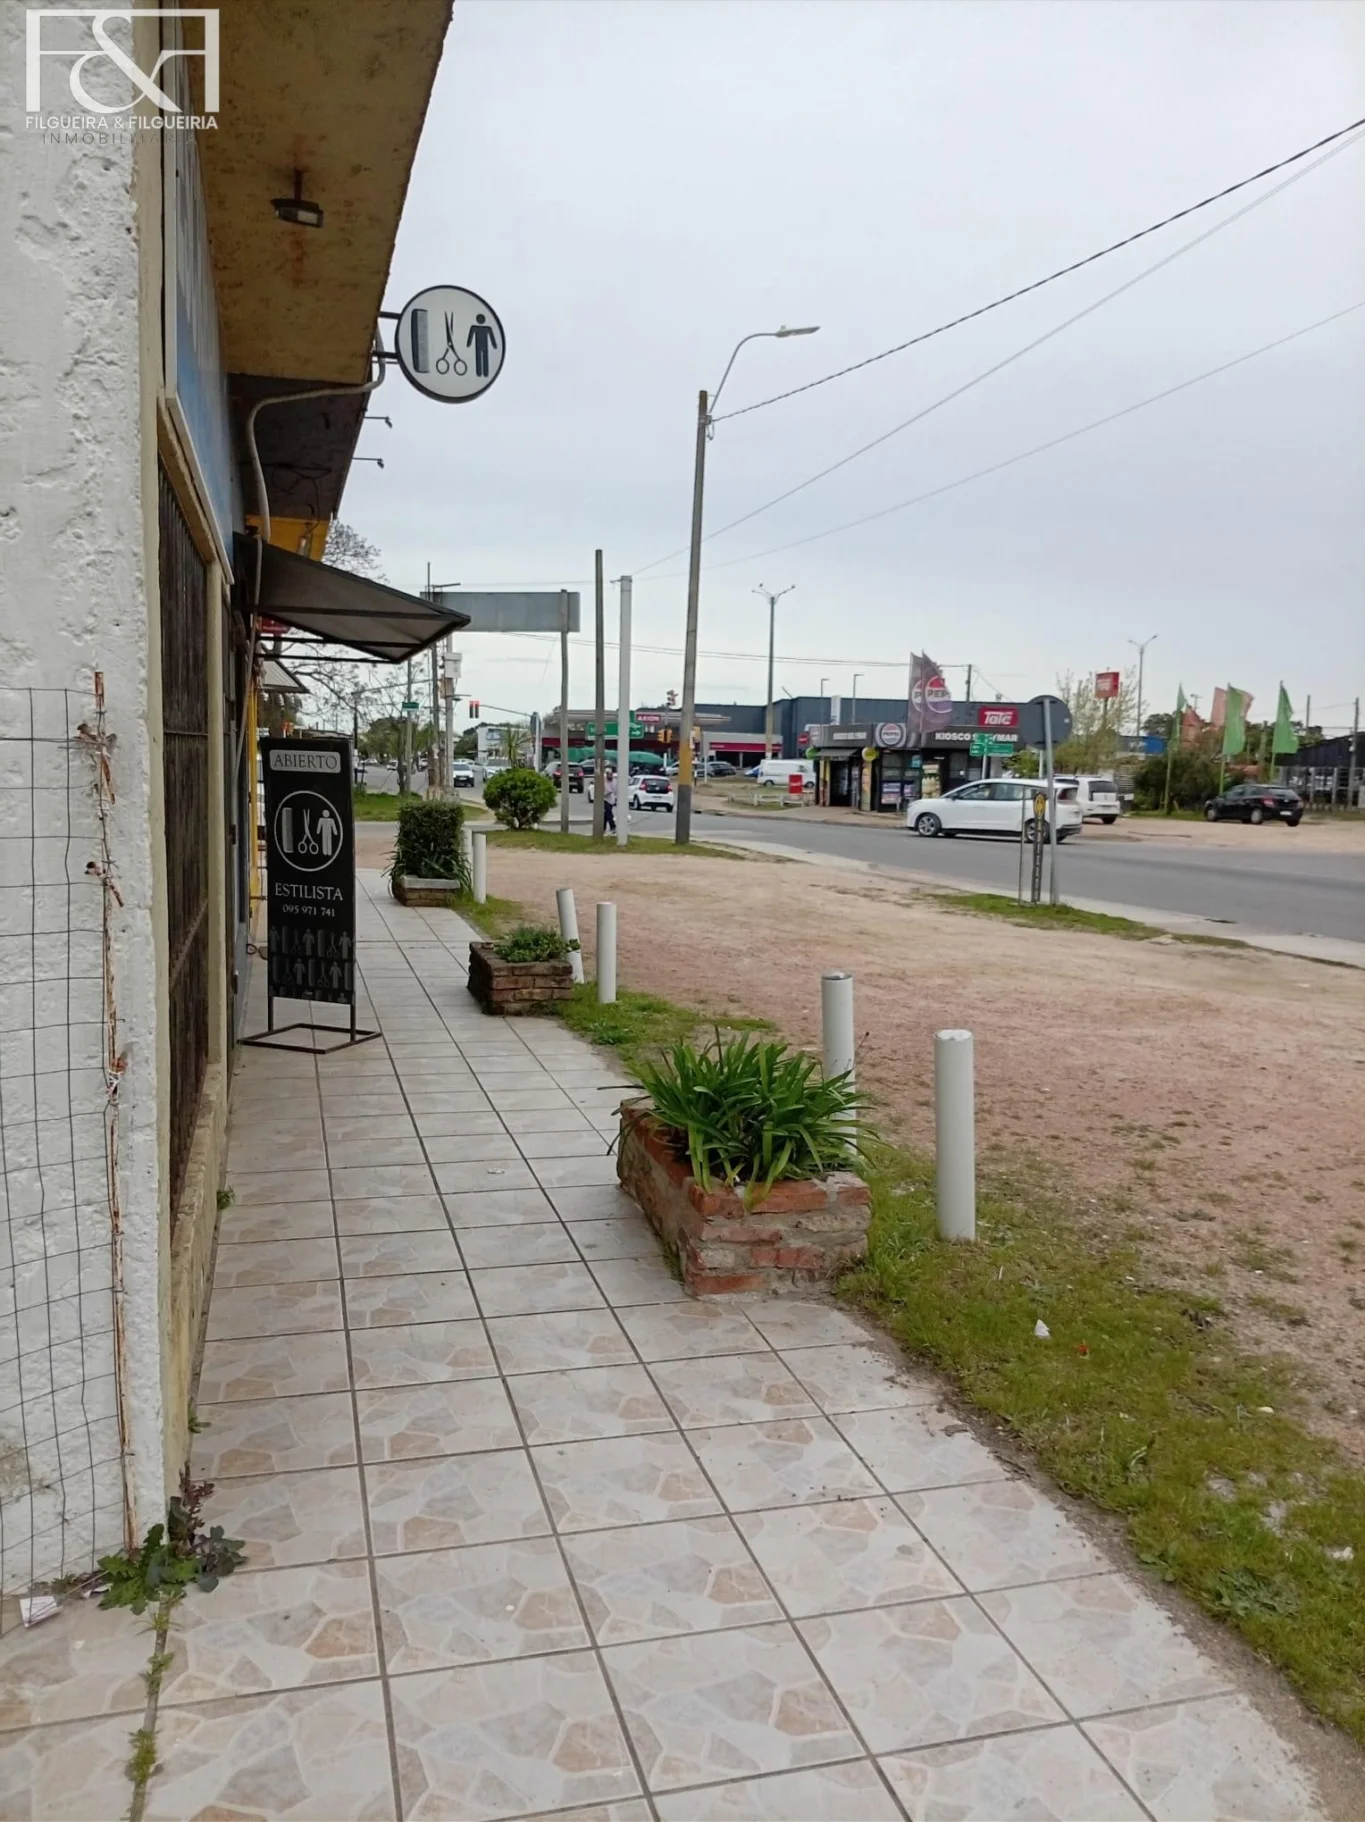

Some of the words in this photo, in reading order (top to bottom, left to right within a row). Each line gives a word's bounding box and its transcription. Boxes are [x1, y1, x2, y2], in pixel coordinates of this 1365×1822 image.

[935, 732, 971, 741] KIOSCO
[274, 753, 338, 769] ABIERTO
[275, 882, 344, 901] ESTILISTA
[282, 904, 299, 914] 095
[302, 905, 317, 915] 971
[320, 907, 335, 917] 741
